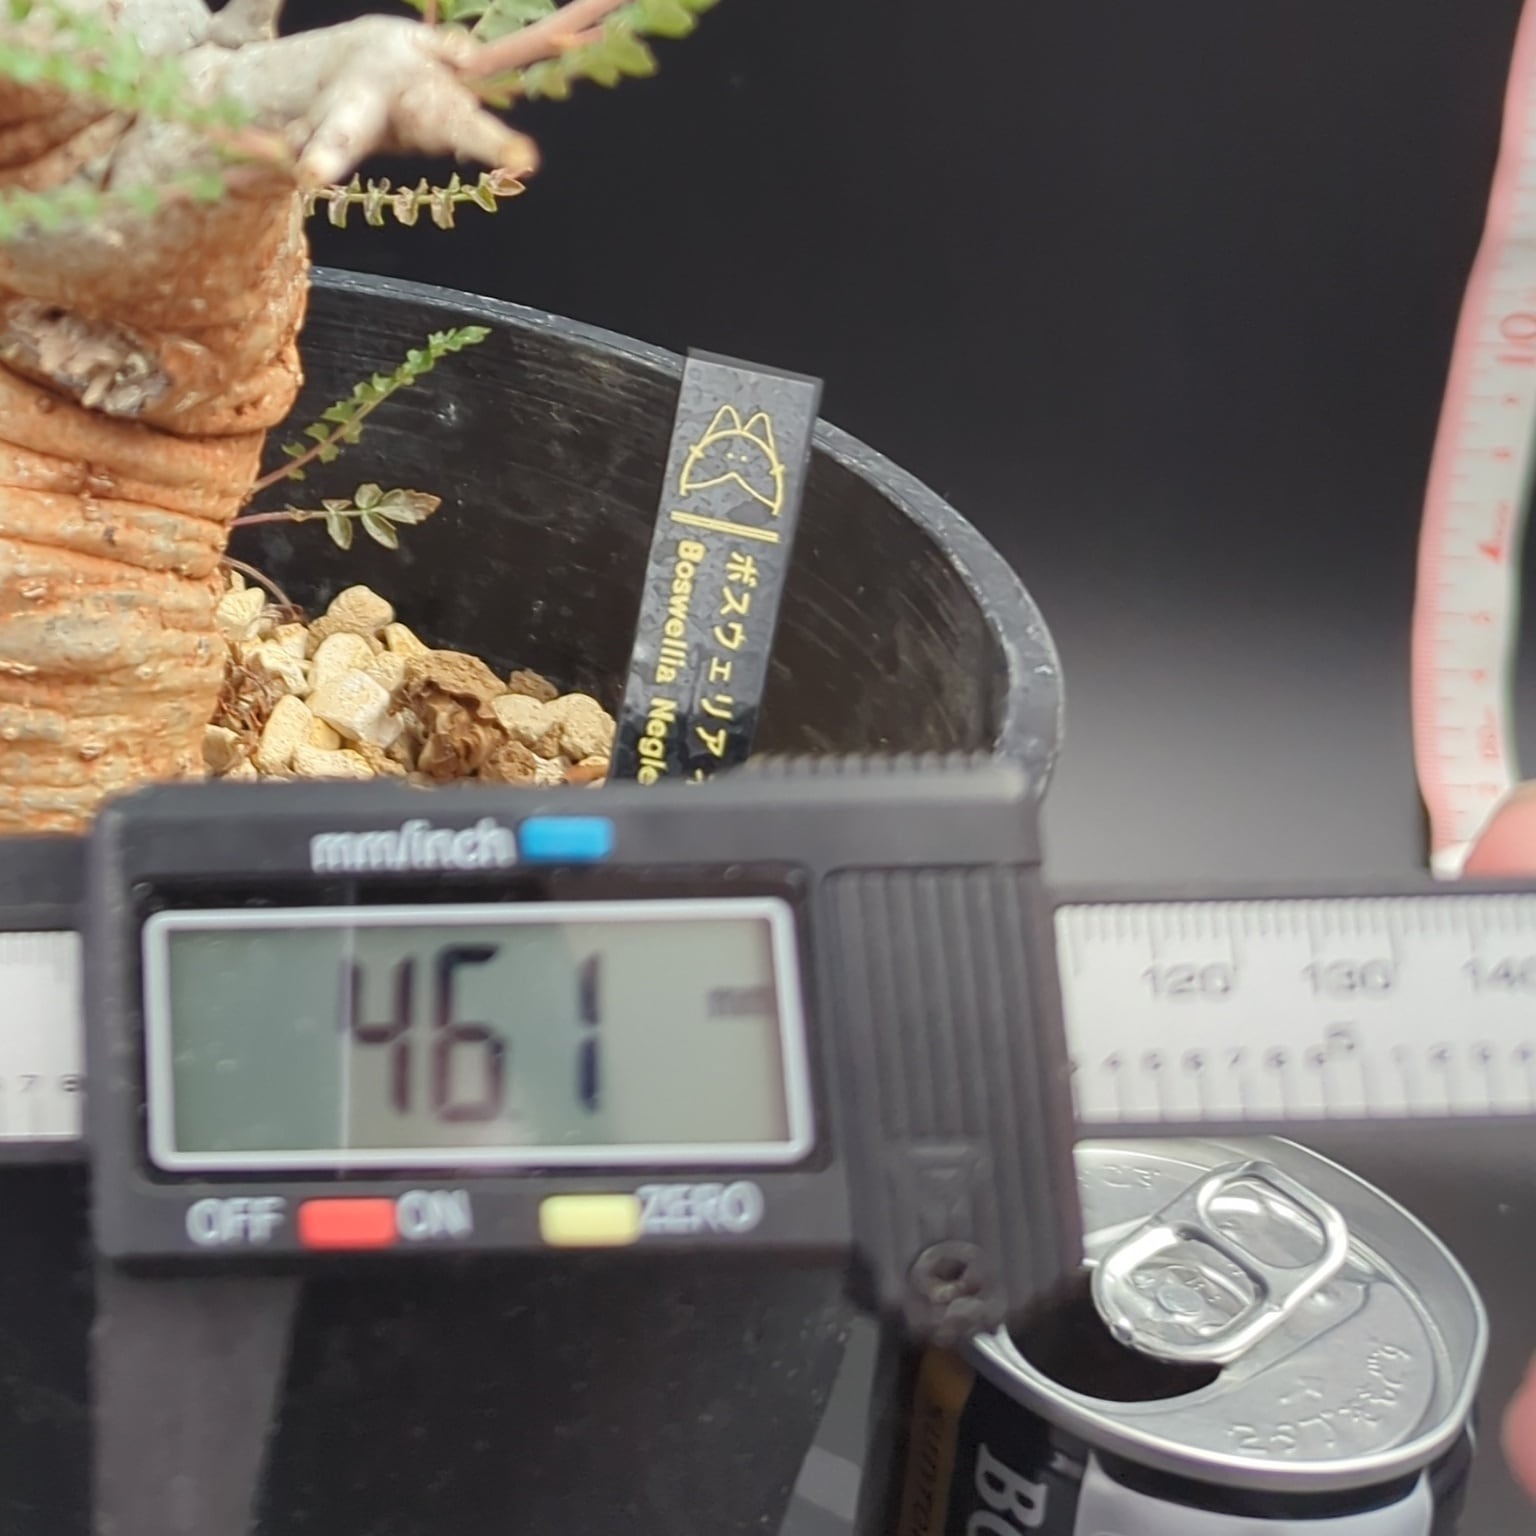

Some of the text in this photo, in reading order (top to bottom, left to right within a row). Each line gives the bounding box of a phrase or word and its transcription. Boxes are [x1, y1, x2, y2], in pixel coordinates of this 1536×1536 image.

[654, 538, 708, 684] Boswellia
[309, 817, 517, 873] mm/inch
[185, 1196, 285, 1245] OFF
[396, 1190, 472, 1240] ON
[636, 1181, 763, 1233] ZERO
